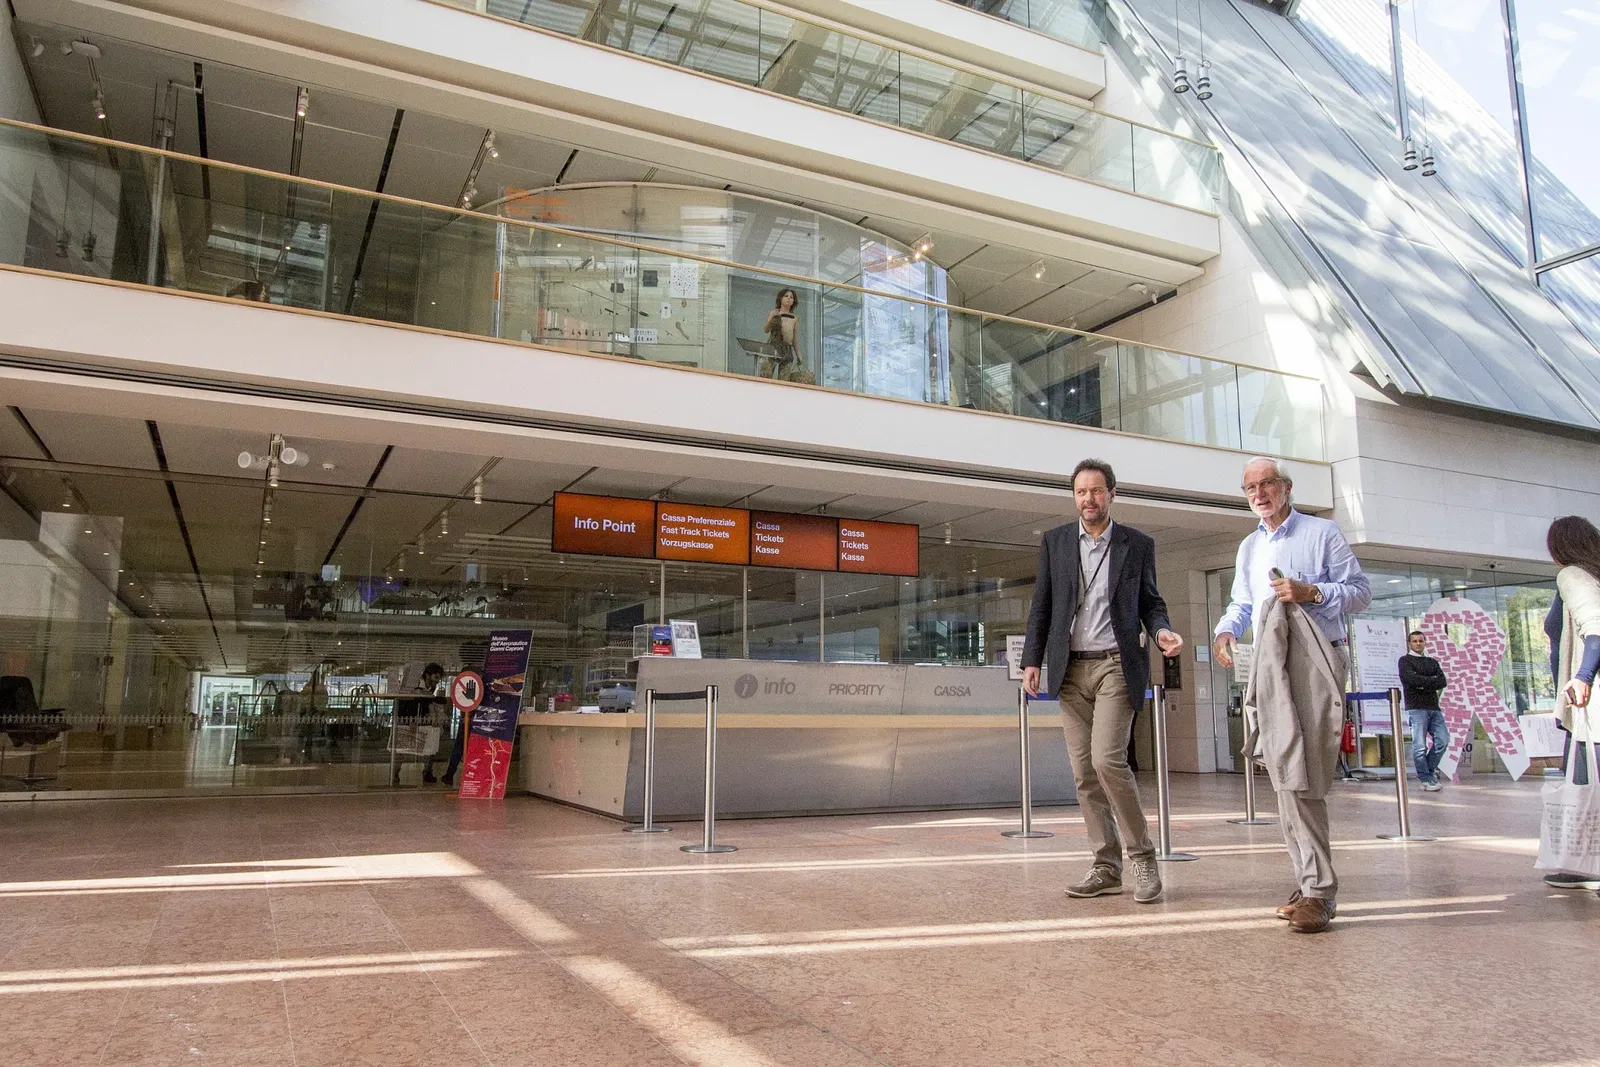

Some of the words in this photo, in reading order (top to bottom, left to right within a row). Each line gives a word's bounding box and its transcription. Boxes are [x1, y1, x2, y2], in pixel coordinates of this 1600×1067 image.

[574, 516, 599, 530] Info
[602, 518, 636, 533] Point
[661, 513, 686, 523] Cassa
[687, 515, 736, 527] Preferenziale
[755, 521, 780, 531] Cassa
[661, 525, 678, 535] Fast
[680, 527, 701, 537] Track
[702, 528, 730, 539] Tickets
[841, 528, 865, 538] Cassa
[755, 533, 784, 543] Tickets
[660, 538, 714, 550] Vorzugskasse
[841, 540, 869, 550] Tickets
[755, 545, 780, 555] Kasse
[841, 552, 865, 562] Kasse
[764, 677, 796, 695] info
[828, 683, 885, 696] PRIORITY
[933, 685, 972, 697] CASSA
